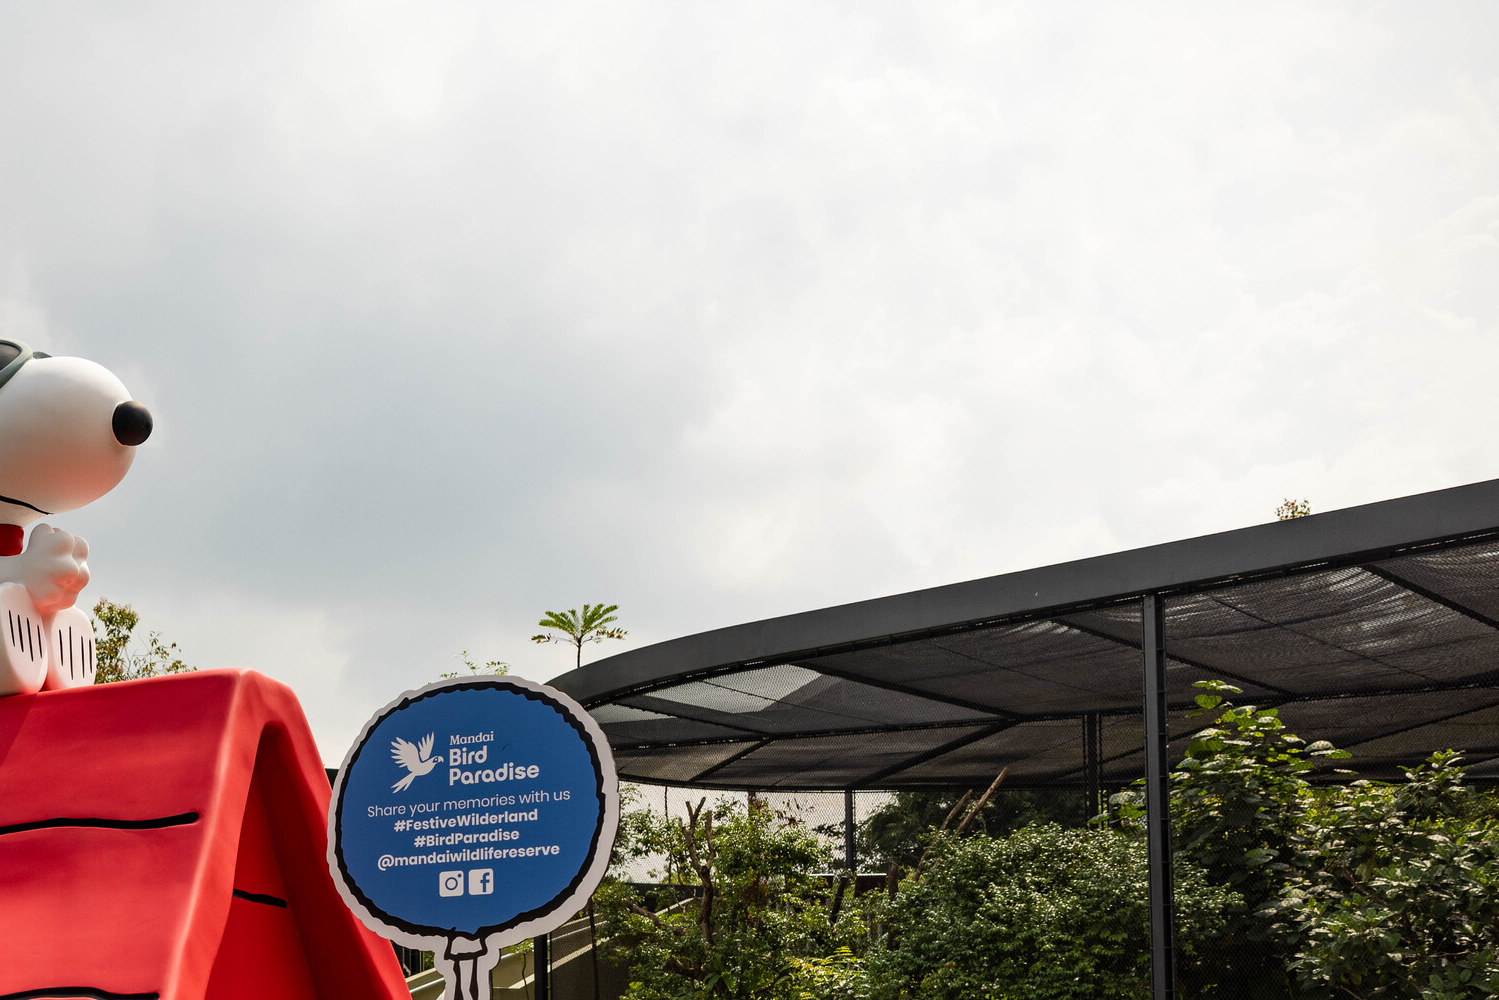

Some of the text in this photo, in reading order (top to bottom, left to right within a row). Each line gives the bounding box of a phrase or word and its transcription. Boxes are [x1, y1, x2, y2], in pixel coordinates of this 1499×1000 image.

[449, 731, 494, 746] Mandai
[449, 745, 487, 767] Bird
[449, 762, 540, 787] Paradise
[367, 789, 571, 818] Share your memories with us
[393, 809, 538, 832] #FestiveWilderland
[413, 829, 520, 848] #BirdParadise
[377, 844, 560, 872] @mandaiwildlifereserve
